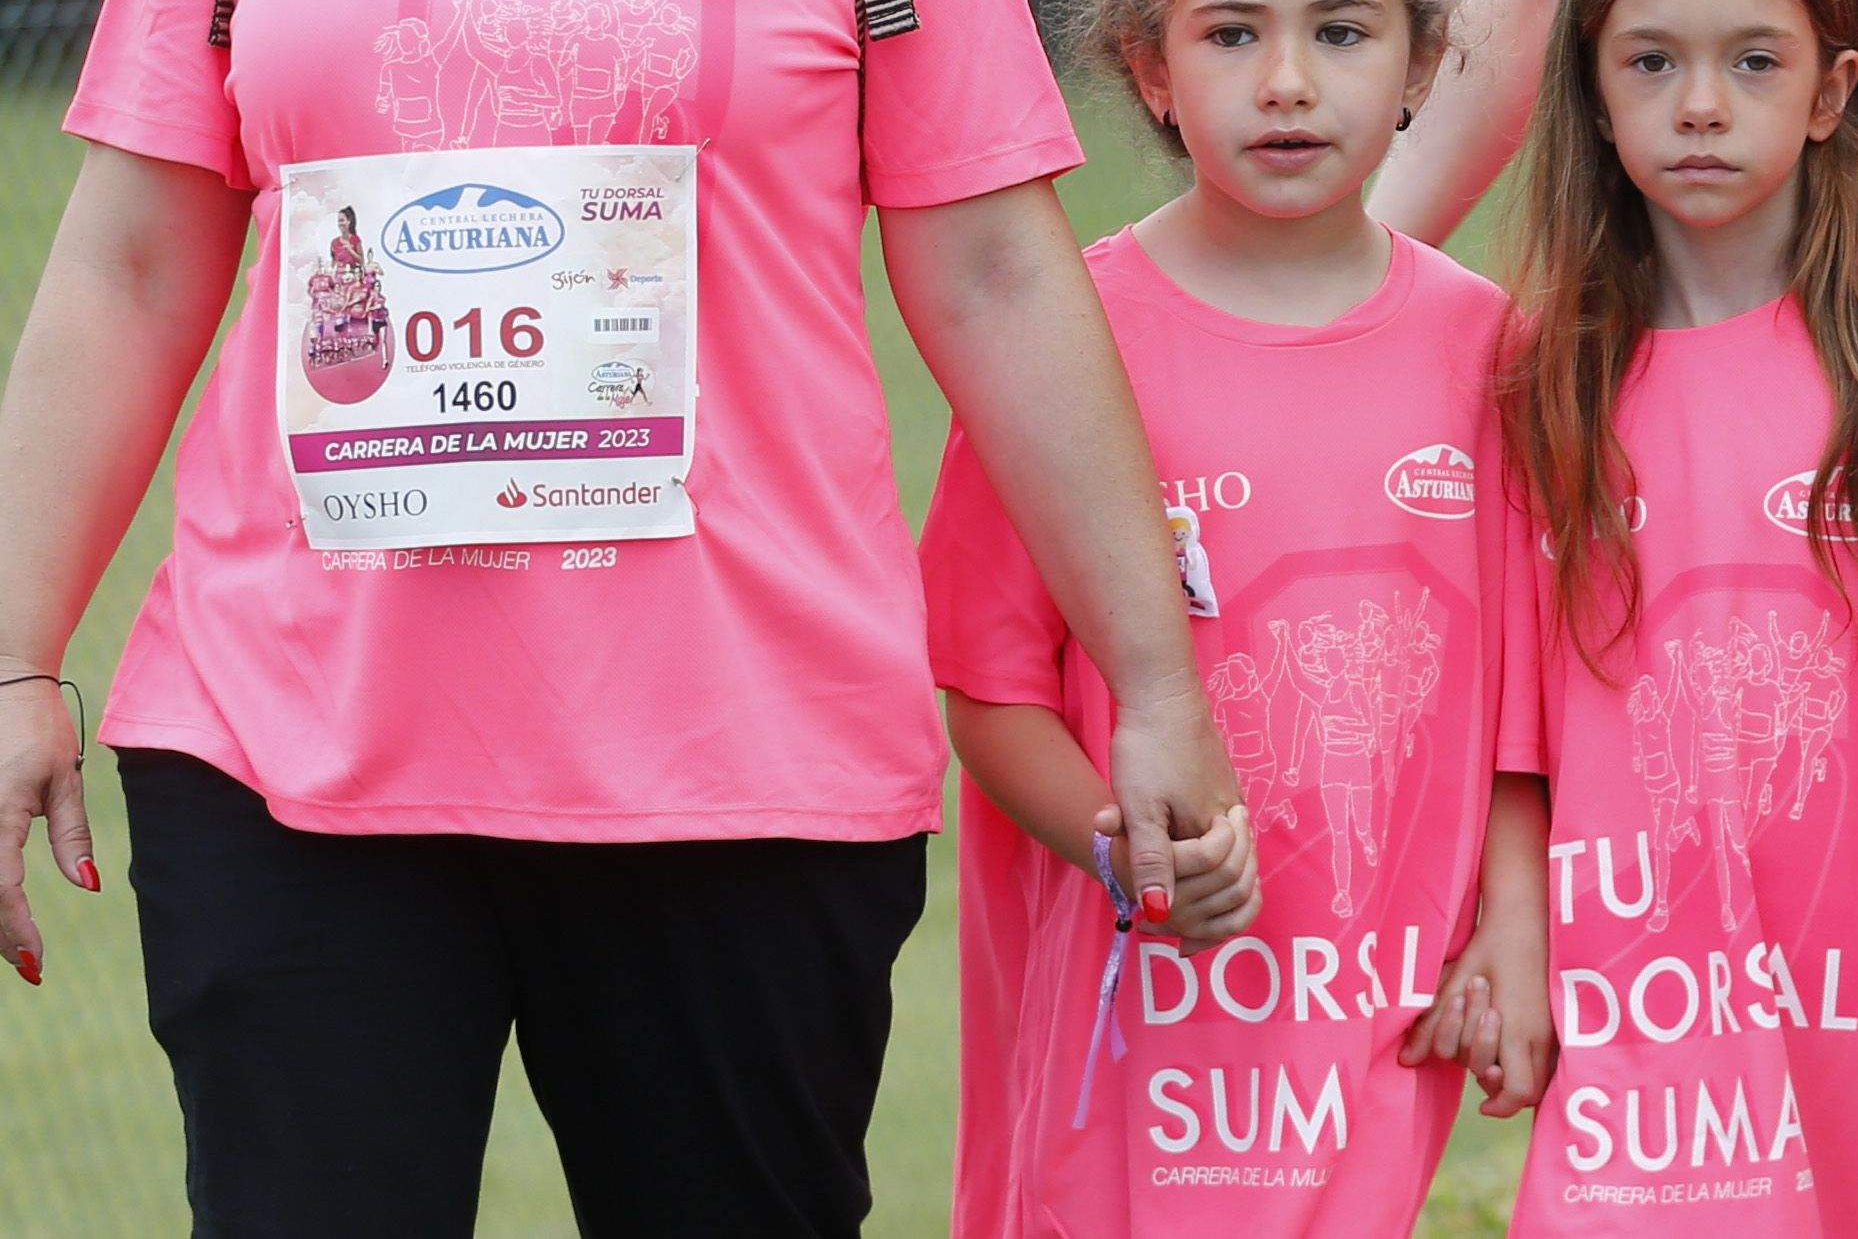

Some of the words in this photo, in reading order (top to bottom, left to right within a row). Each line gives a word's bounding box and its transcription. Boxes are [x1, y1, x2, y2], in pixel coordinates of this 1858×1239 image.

[581, 188, 598, 200] TU
[602, 187, 665, 200] DORSAL
[420, 214, 478, 226] CENTRAL
[483, 212, 544, 224] LECHERA
[581, 201, 664, 221] SUMA
[394, 220, 551, 254] ASTURIANA
[405, 306, 545, 362] 016
[448, 361, 493, 370] VIOLENCIA
[494, 360, 507, 369] DE
[433, 380, 517, 414] 1460
[324, 434, 425, 461] CARRERA
[430, 434, 461, 454] DE
[466, 433, 498, 452] LA
[503, 430, 588, 451] MUJER
[598, 428, 651, 448] 2023
[323, 488, 428, 522] OYSHO
[533, 481, 661, 507] Santander
[321, 549, 387, 571] CARRERA
[393, 548, 425, 570] DE
[428, 547, 455, 566] LA
[461, 548, 531, 571] MUJER
[560, 548, 618, 571] 2023
[1549, 830, 1654, 924] TU
[1148, 1062, 1348, 1154] SUM
[1565, 1070, 1809, 1172] SUMA
[1152, 1166, 1241, 1186] CARRERA
[1243, 1167, 1262, 1187] DE
[1264, 1168, 1285, 1187] LA
[1564, 1183, 1657, 1205] CARRERA
[1661, 1183, 1684, 1203] DE
[1687, 1182, 1710, 1201] LA
[1714, 1176, 1773, 1199] MUJER
